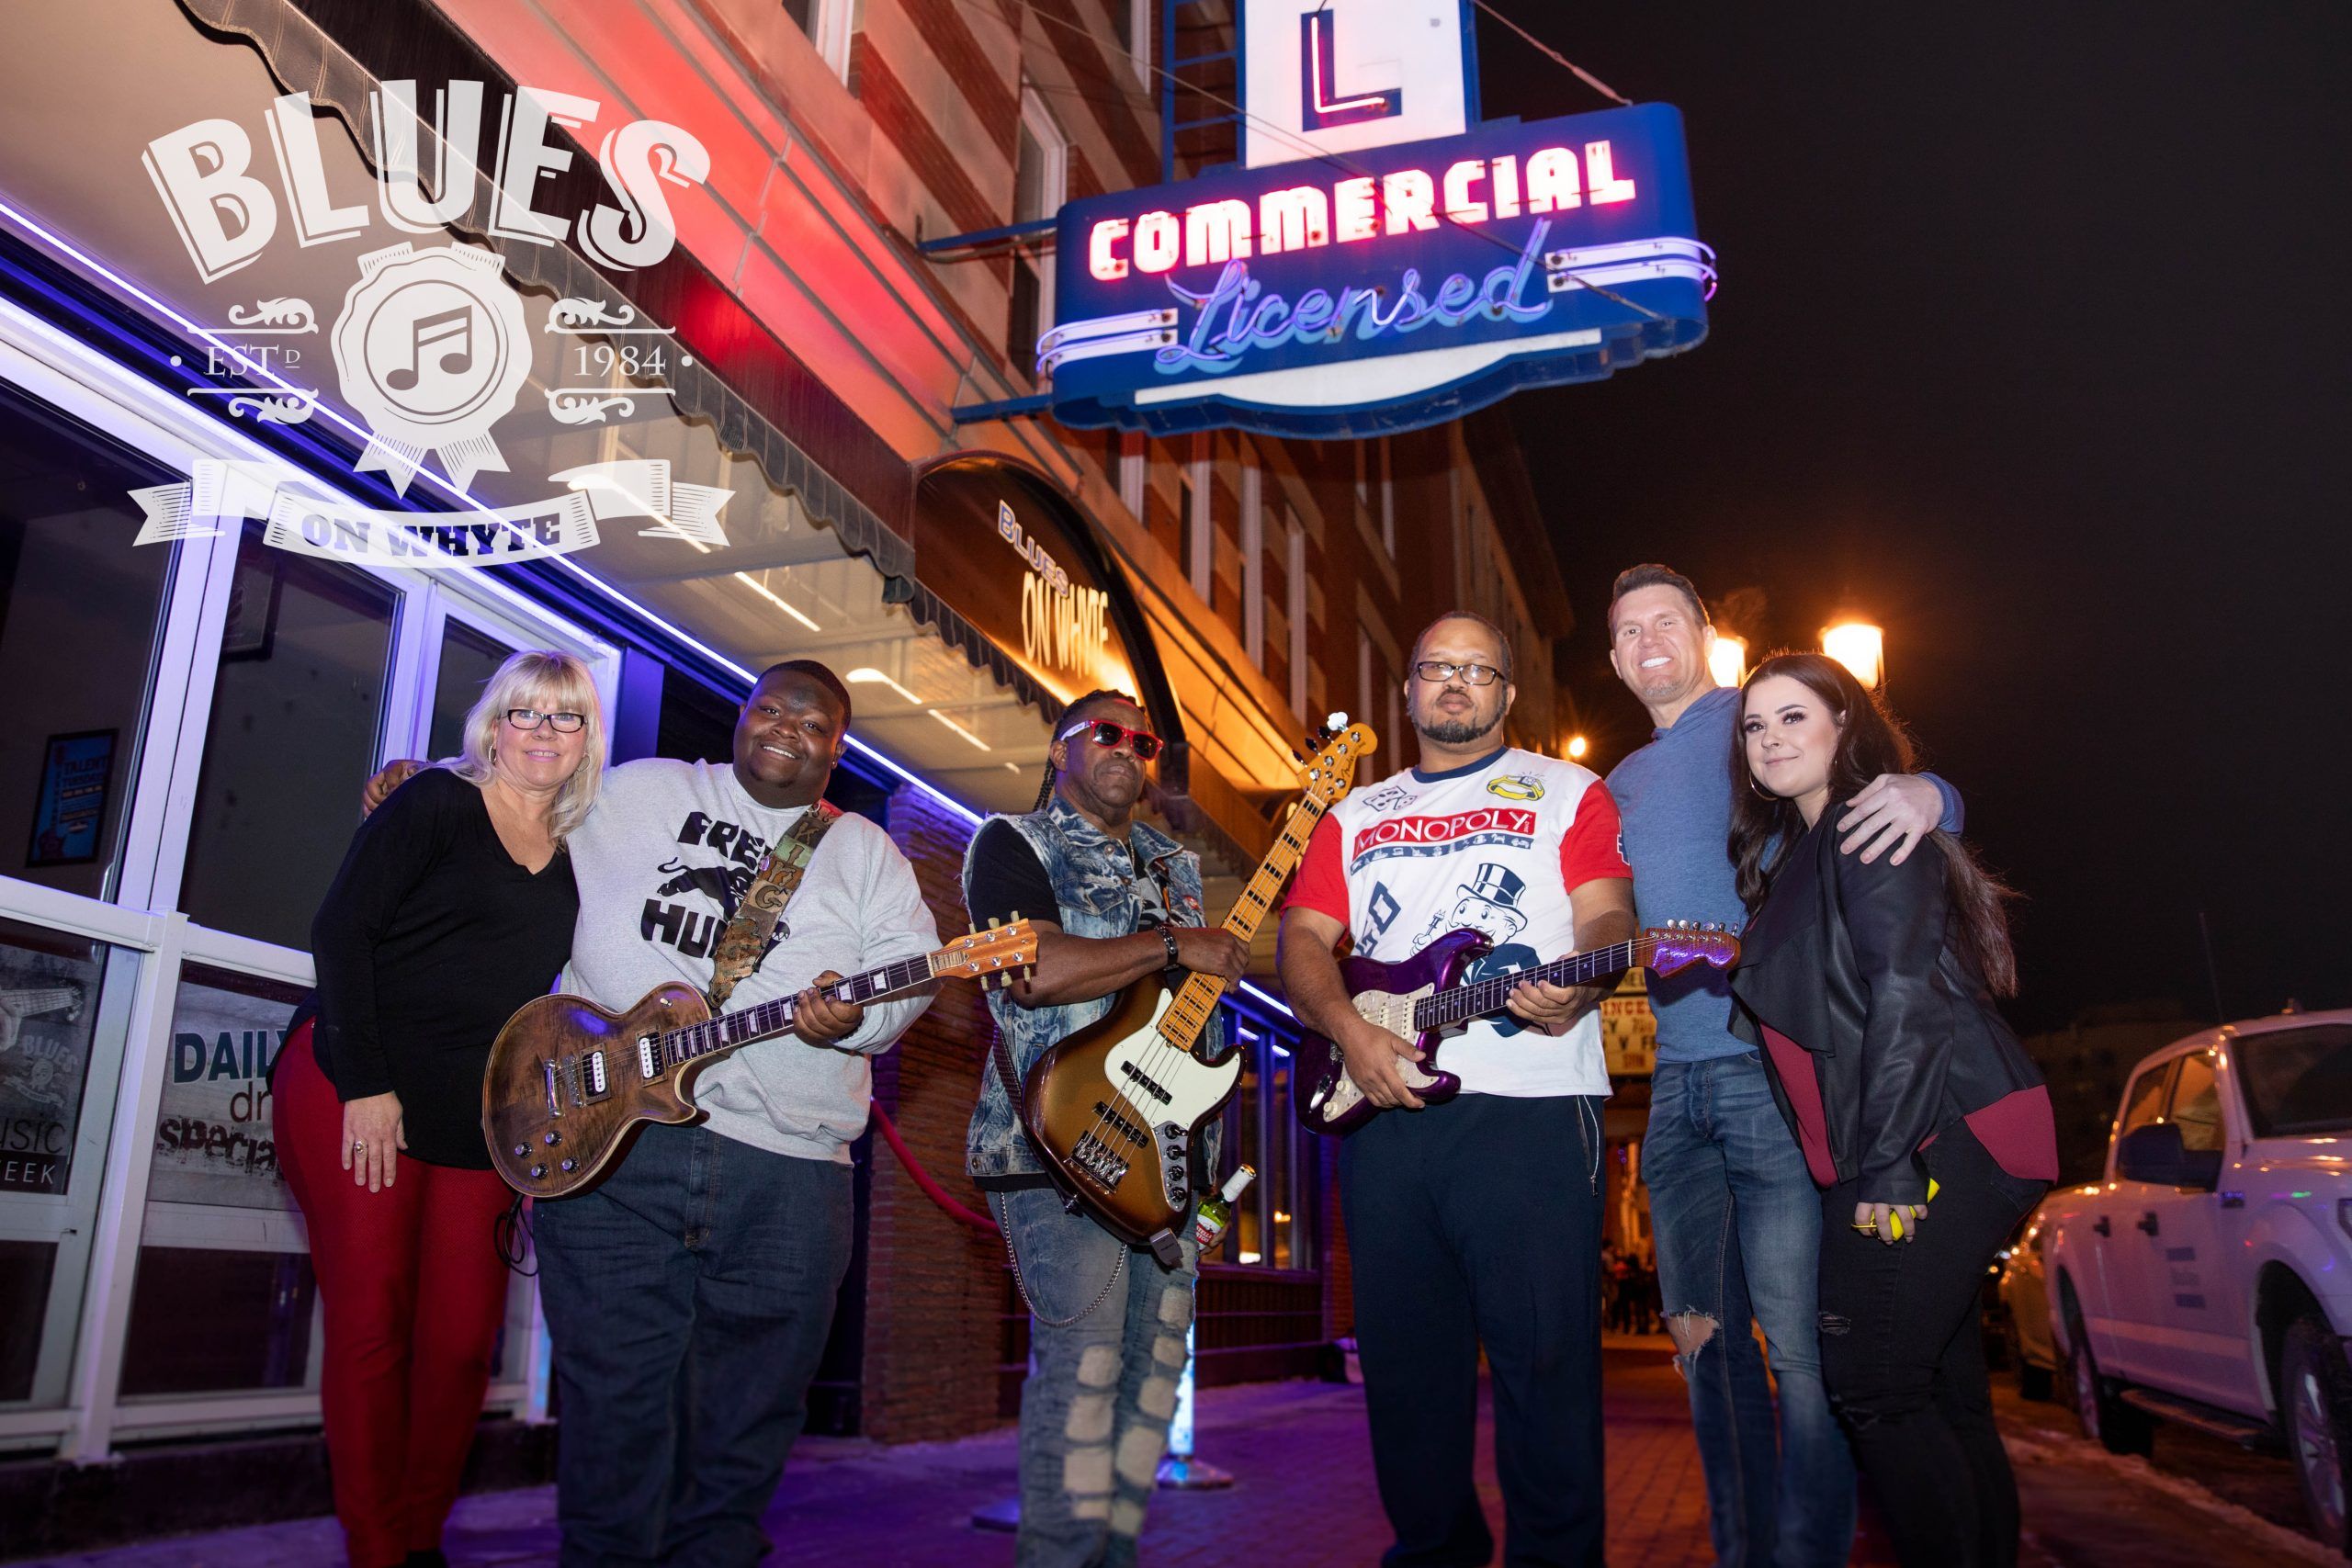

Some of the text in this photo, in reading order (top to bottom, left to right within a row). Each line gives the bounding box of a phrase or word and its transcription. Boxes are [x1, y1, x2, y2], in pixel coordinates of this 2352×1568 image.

[1089, 140, 1636, 281] COMMERCIAL
[1154, 217, 1555, 374] Licensed
[998, 499, 1069, 598] BLUES
[1022, 570, 1051, 670] ON
[1355, 808, 1531, 854] MONOPOLY
[22, 1034, 79, 1073] BLUES
[0, 1160, 56, 1185] EEK
